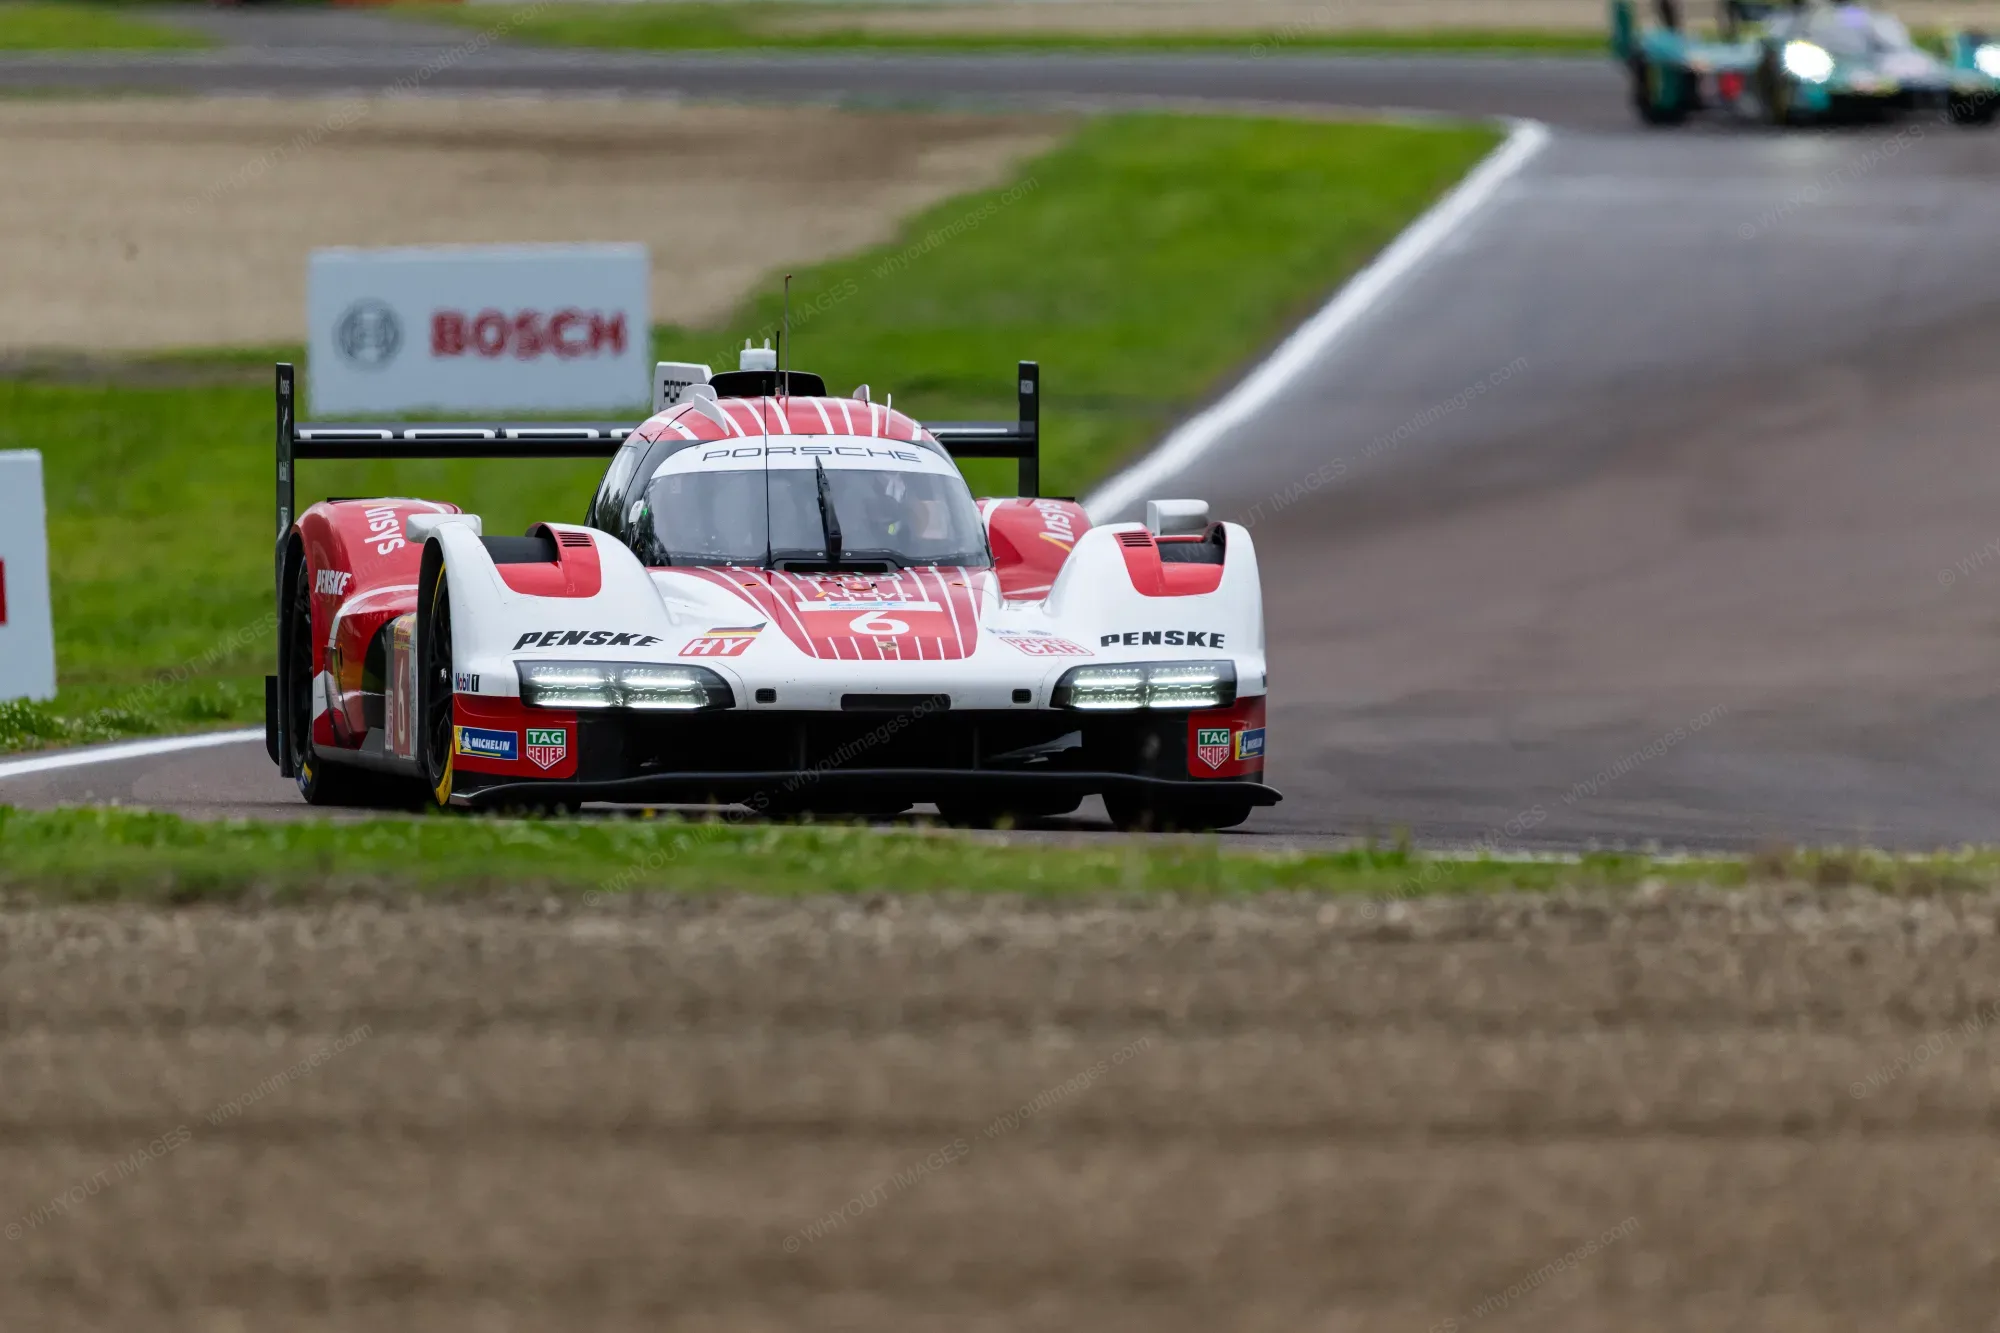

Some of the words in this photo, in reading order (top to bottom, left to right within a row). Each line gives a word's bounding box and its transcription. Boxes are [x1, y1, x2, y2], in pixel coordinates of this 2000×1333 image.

[430, 308, 628, 359] BOSCH
[702, 446, 922, 463] PORSCHE
[315, 569, 352, 596] PENSKE
[849, 611, 910, 635] 6
[512, 630, 663, 650] PENSKE
[682, 637, 747, 656] HY
[1019, 644, 1087, 654] CAR
[1100, 630, 1225, 649] PENSKE
[455, 672, 470, 691] Mobil
[471, 675, 480, 691] 1
[471, 738, 510, 751] MICHELIN
[530, 732, 563, 744] TAG
[1201, 731, 1228, 744] TAG
[528, 747, 565, 767] HEUER
[1200, 746, 1229, 766] HEUER
